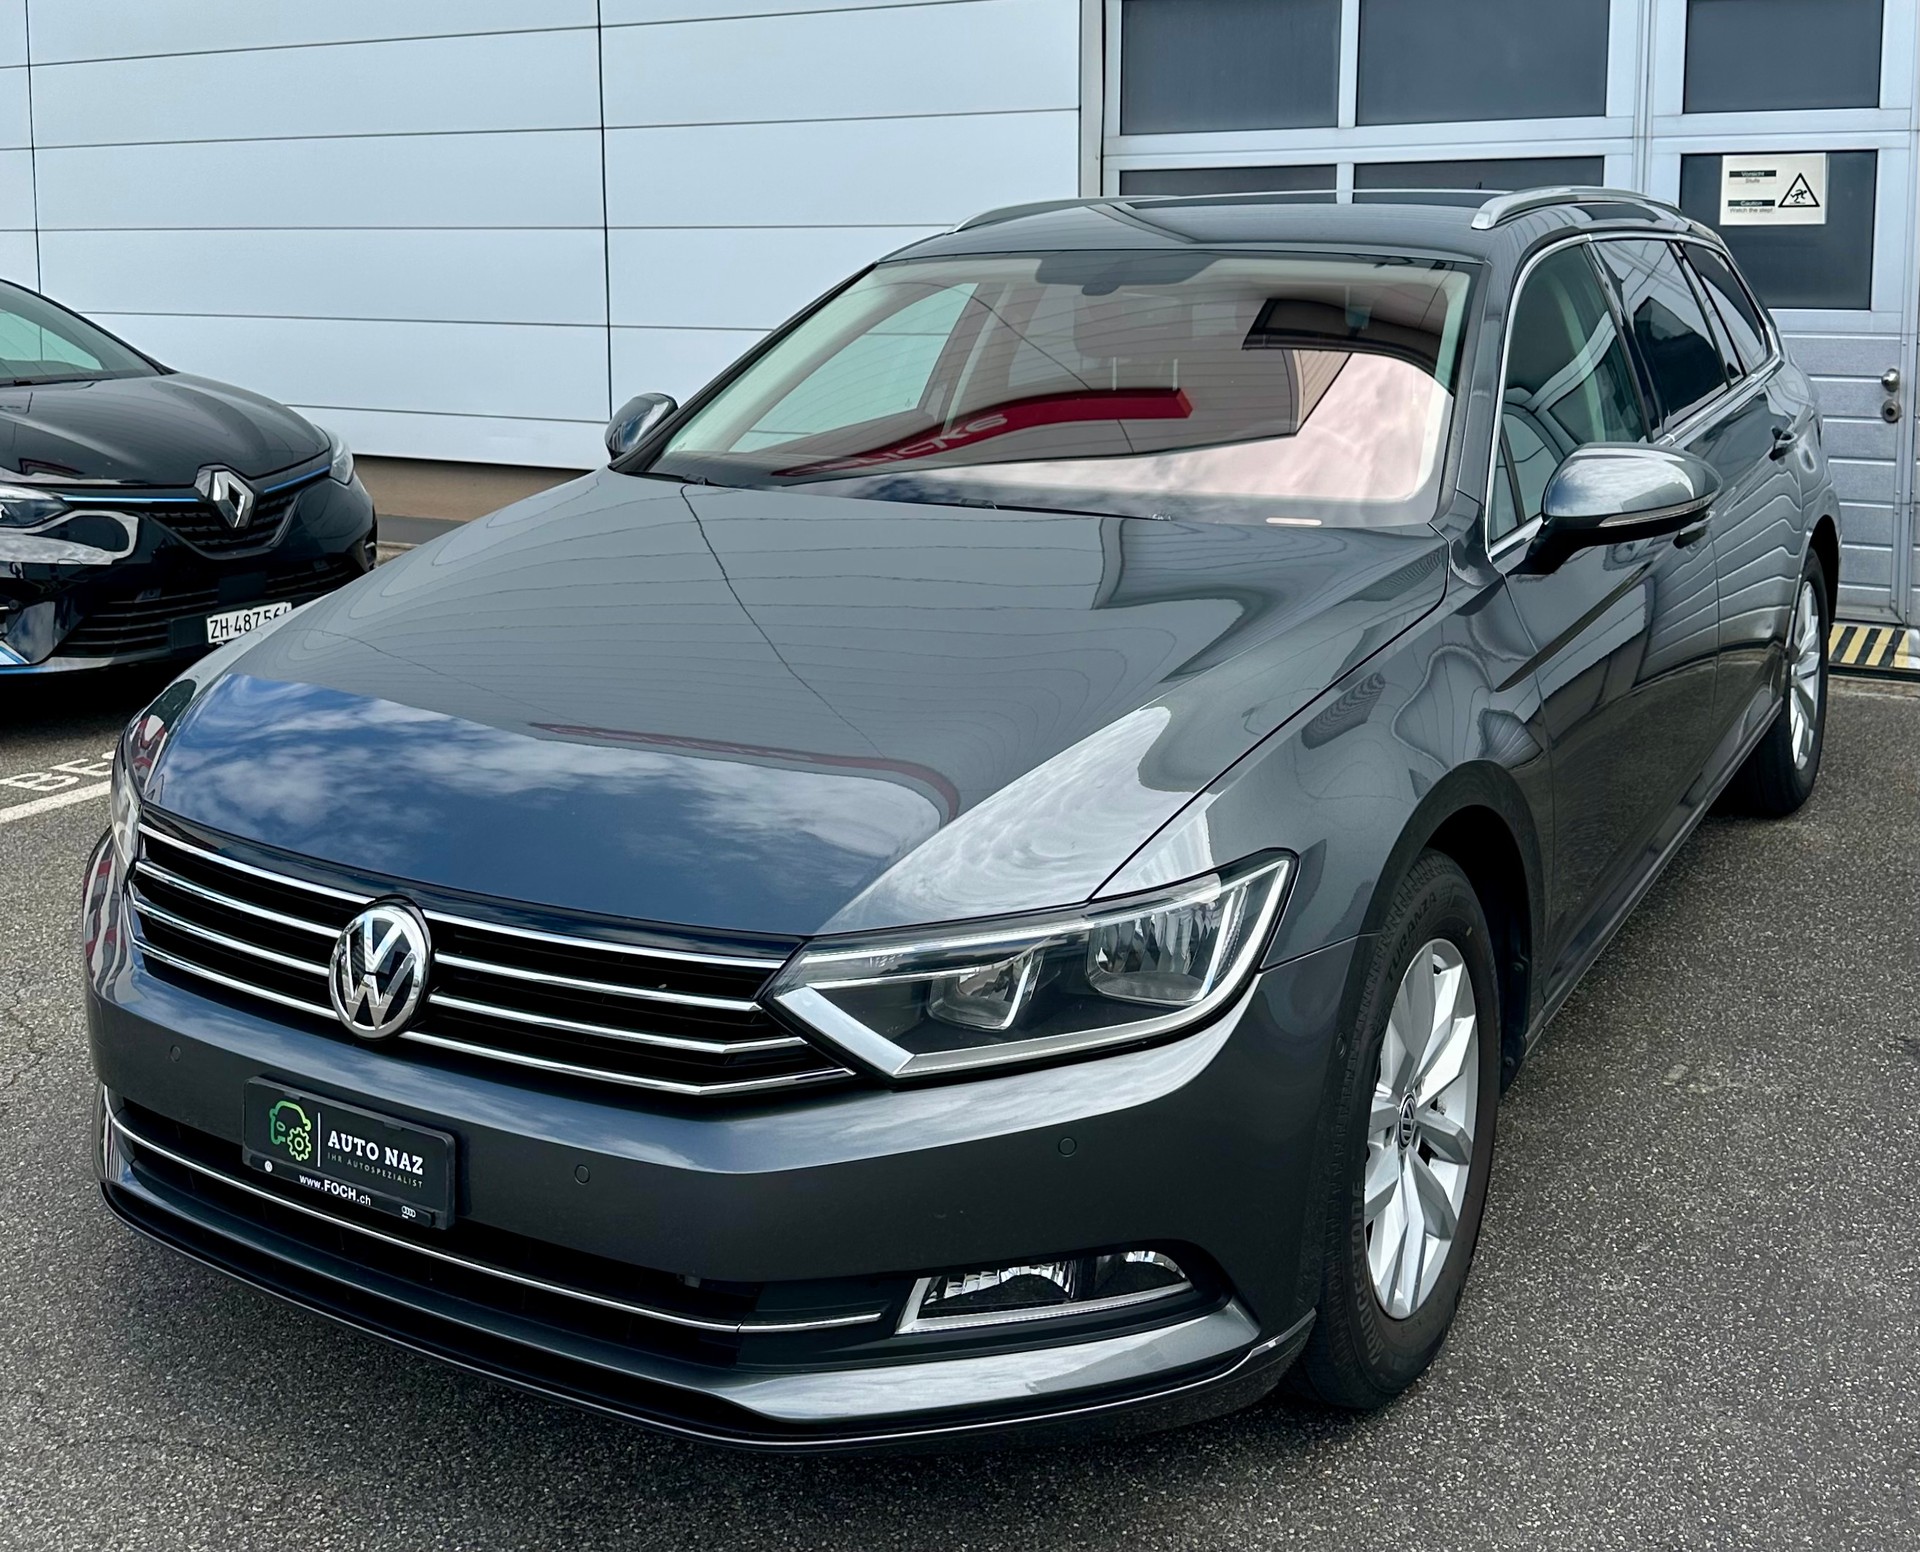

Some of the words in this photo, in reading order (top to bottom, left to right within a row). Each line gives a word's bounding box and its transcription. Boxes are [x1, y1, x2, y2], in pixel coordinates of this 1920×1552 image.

[327, 1130, 379, 1161] AUTO
[384, 1146, 424, 1176] NAZ
[327, 1152, 343, 1164] IHR
[347, 1158, 423, 1189] AUTOSPEZIALIST
[299, 1174, 371, 1206] www.FOCH.ch
